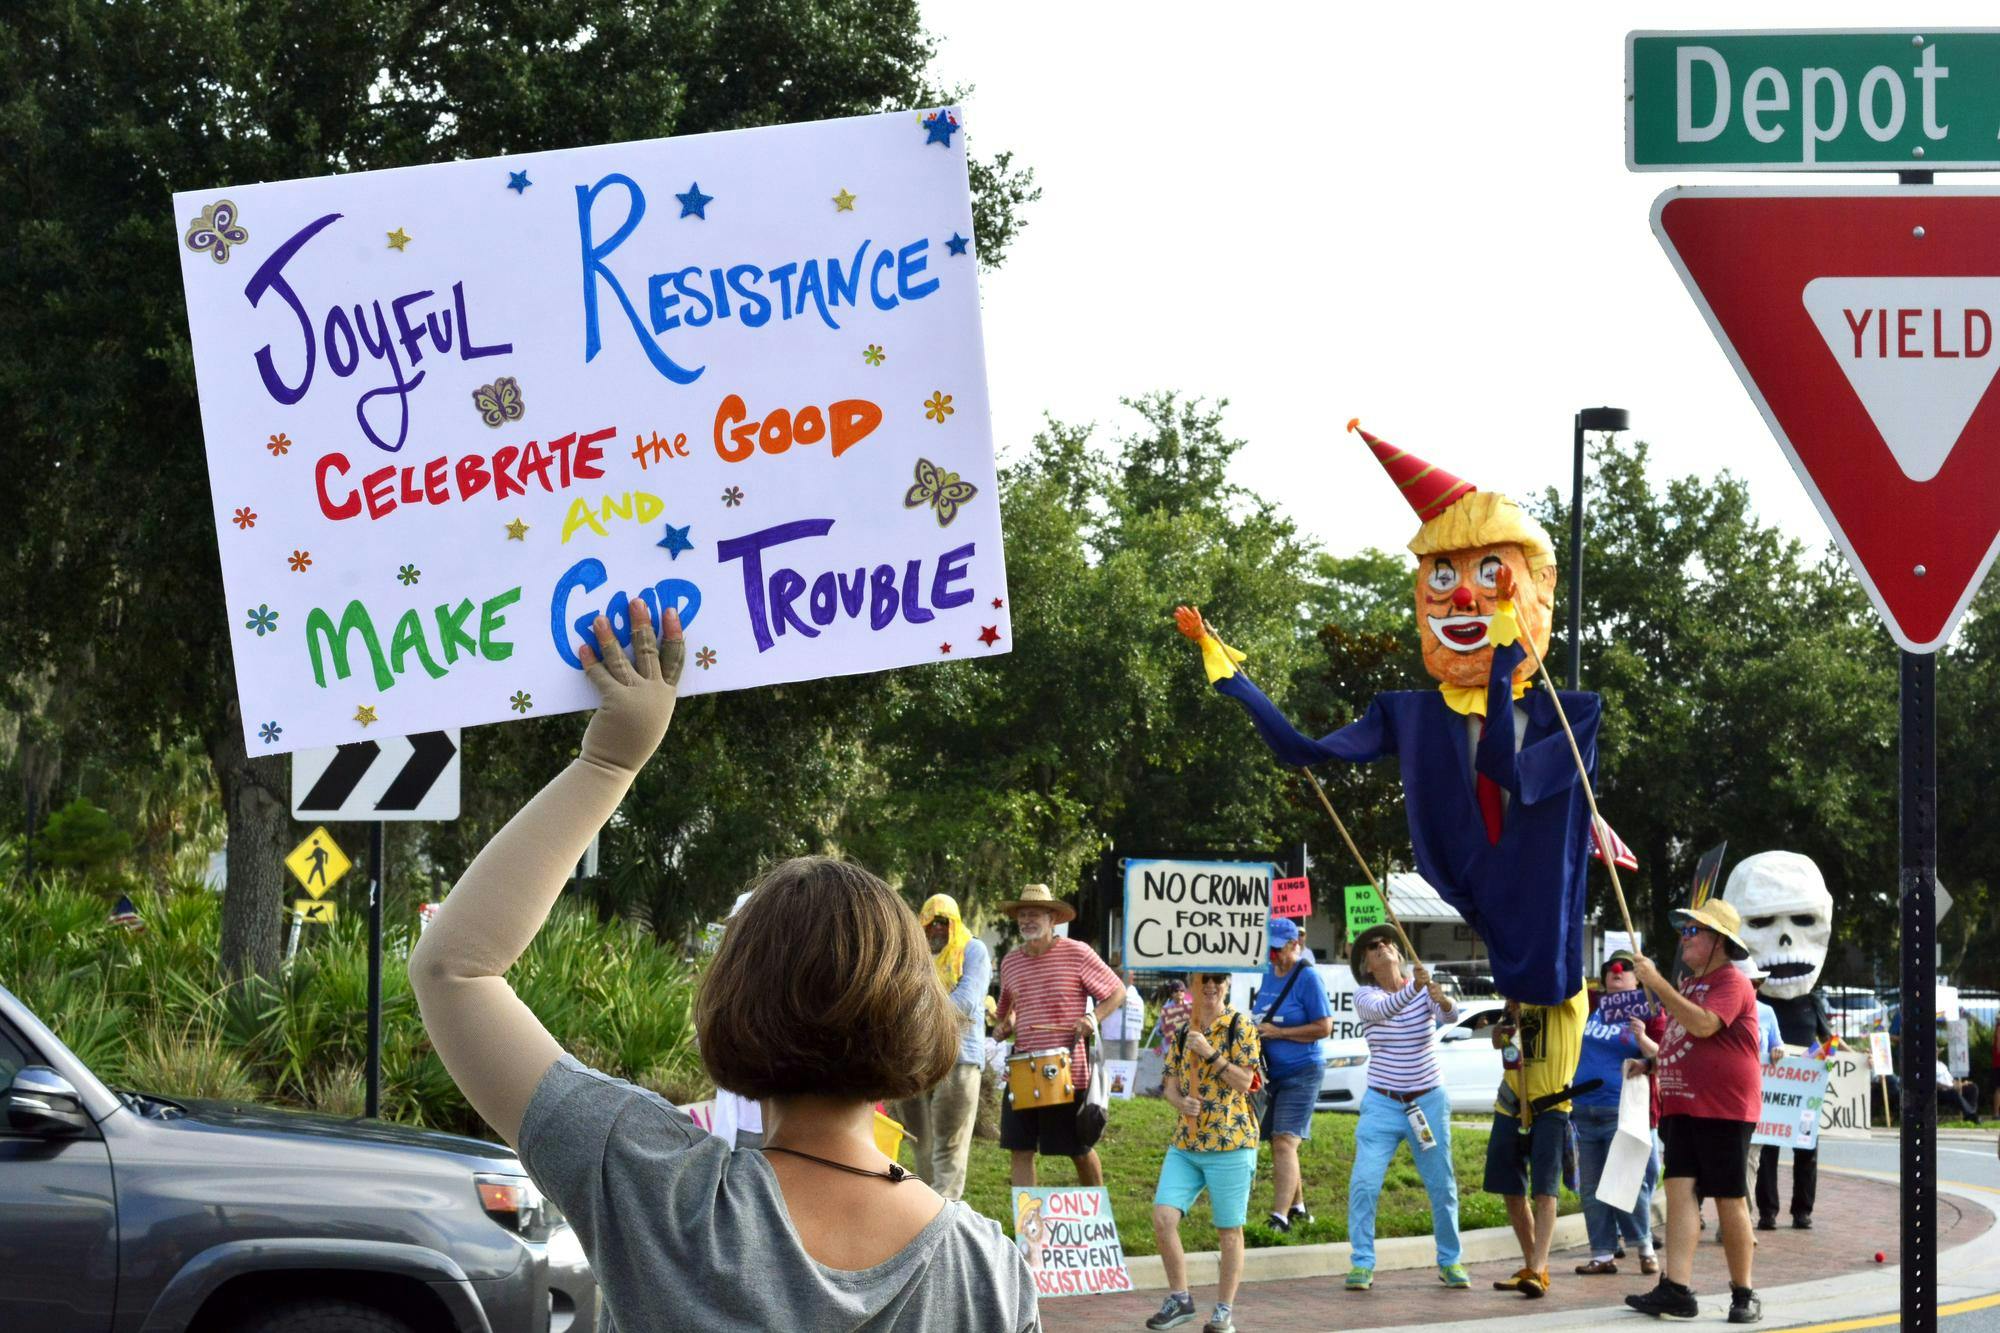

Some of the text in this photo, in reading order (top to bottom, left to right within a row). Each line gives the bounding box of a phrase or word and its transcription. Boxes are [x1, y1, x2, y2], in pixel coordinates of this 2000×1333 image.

[1676, 43, 1949, 162] Depot
[245, 173, 940, 452] JOYFUL RESISTANCE
[1843, 309, 1993, 358] YIELD
[315, 394, 882, 520] CELEBRATE the GOOD
[561, 490, 664, 544] AND
[306, 587, 522, 692] MAKE
[717, 518, 976, 653] TROUBLE
[1144, 871, 1269, 907] NO CROWN
[1277, 881, 1305, 890] KINGS
[1355, 891, 1370, 900] NO
[1176, 911, 1265, 928] FOR THE
[1271, 904, 1307, 914] ERICA!
[1354, 916, 1377, 924] KING
[1133, 918, 1262, 965] CLOWN!
[1600, 990, 1641, 1010] FIGHT
[1049, 1192, 1100, 1216] ONLY
[1045, 1221, 1115, 1246] YOU CAN
[1041, 1245, 1119, 1269] PREVENT
